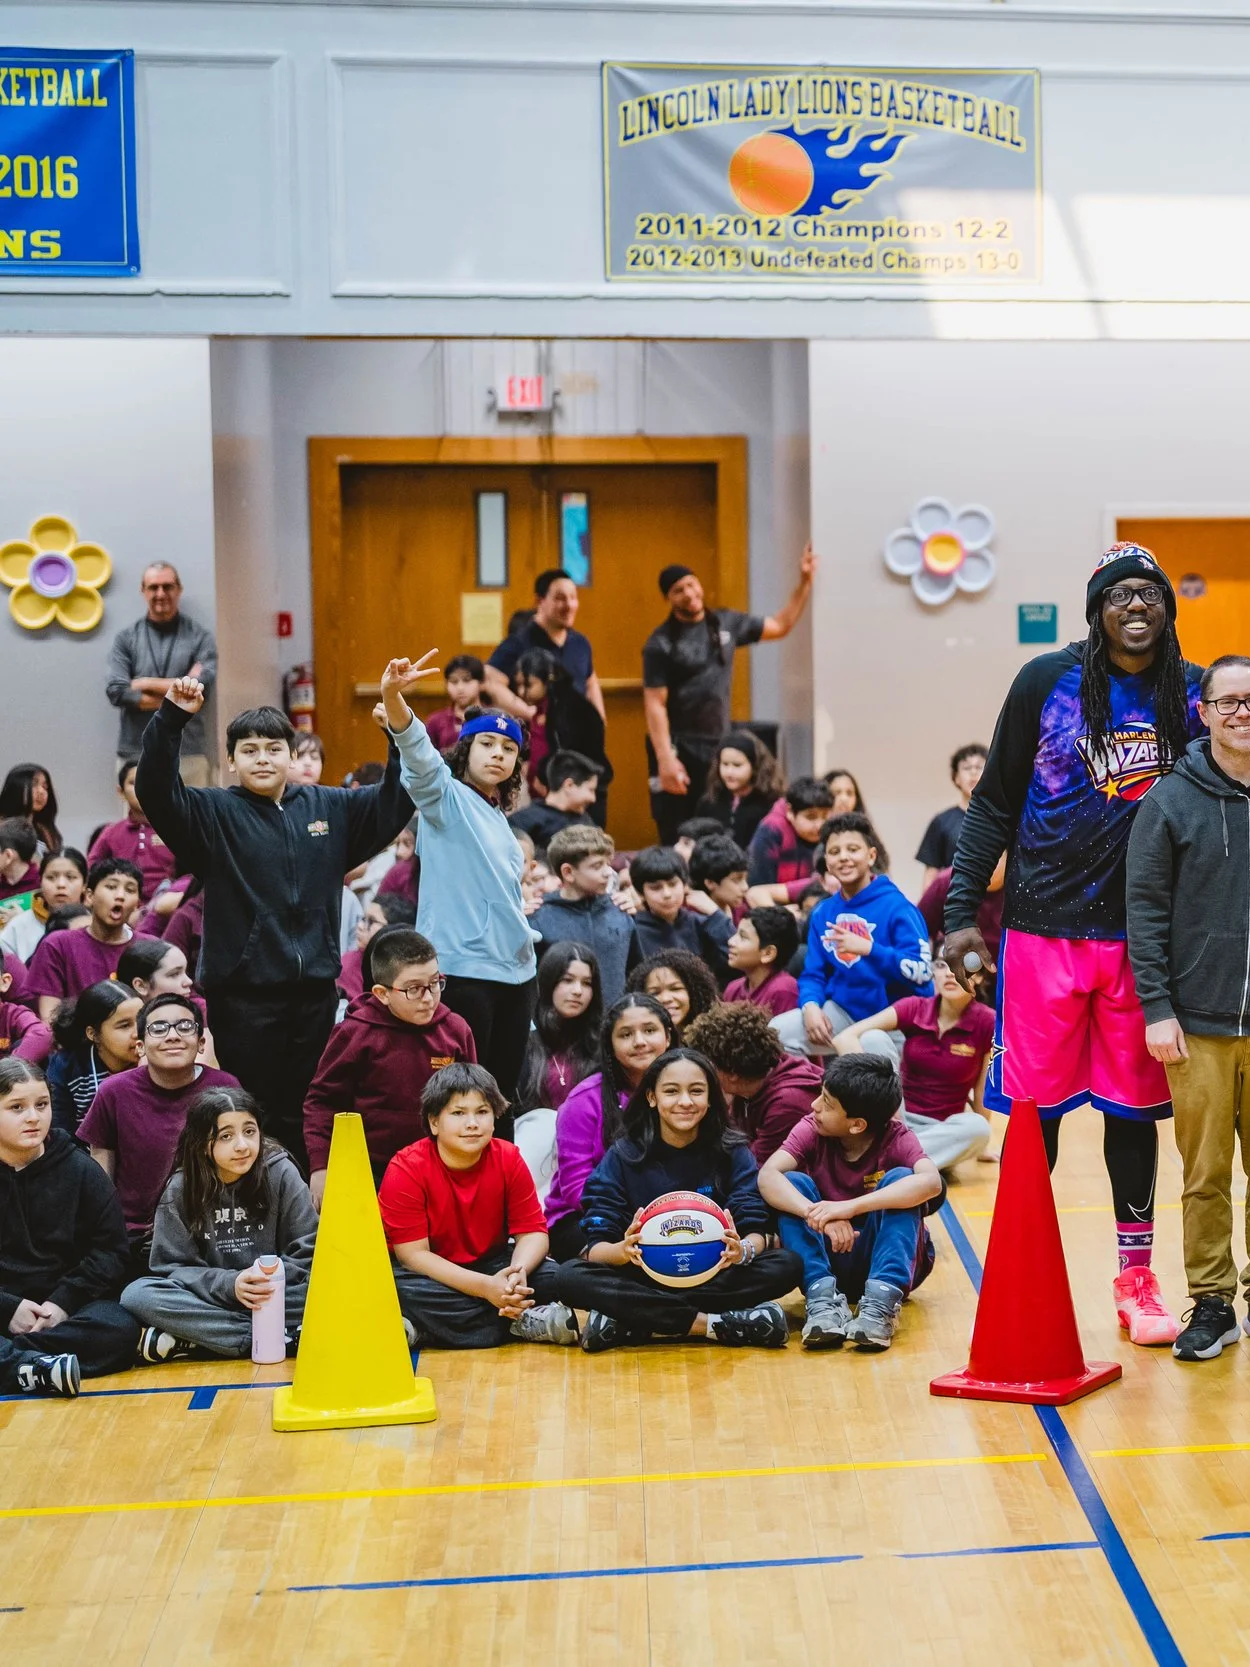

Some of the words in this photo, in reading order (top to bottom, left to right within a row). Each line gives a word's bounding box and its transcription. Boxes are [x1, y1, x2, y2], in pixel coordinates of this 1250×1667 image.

[621, 83, 721, 143] LINCOLN
[727, 78, 790, 120] LADY
[796, 78, 863, 116] LIONS
[868, 80, 1023, 148] BASKETBALL
[638, 215, 783, 237] 2011-2012
[791, 217, 943, 242] Champions
[953, 219, 1010, 239] 12-2
[628, 248, 743, 267] 2012-2013
[749, 249, 875, 269] Undefeated
[881, 251, 968, 272] Champs
[974, 251, 1020, 271] 13-0
[1114, 731, 1157, 740] HARLEM
[662, 1218, 702, 1231] WIZARDS
